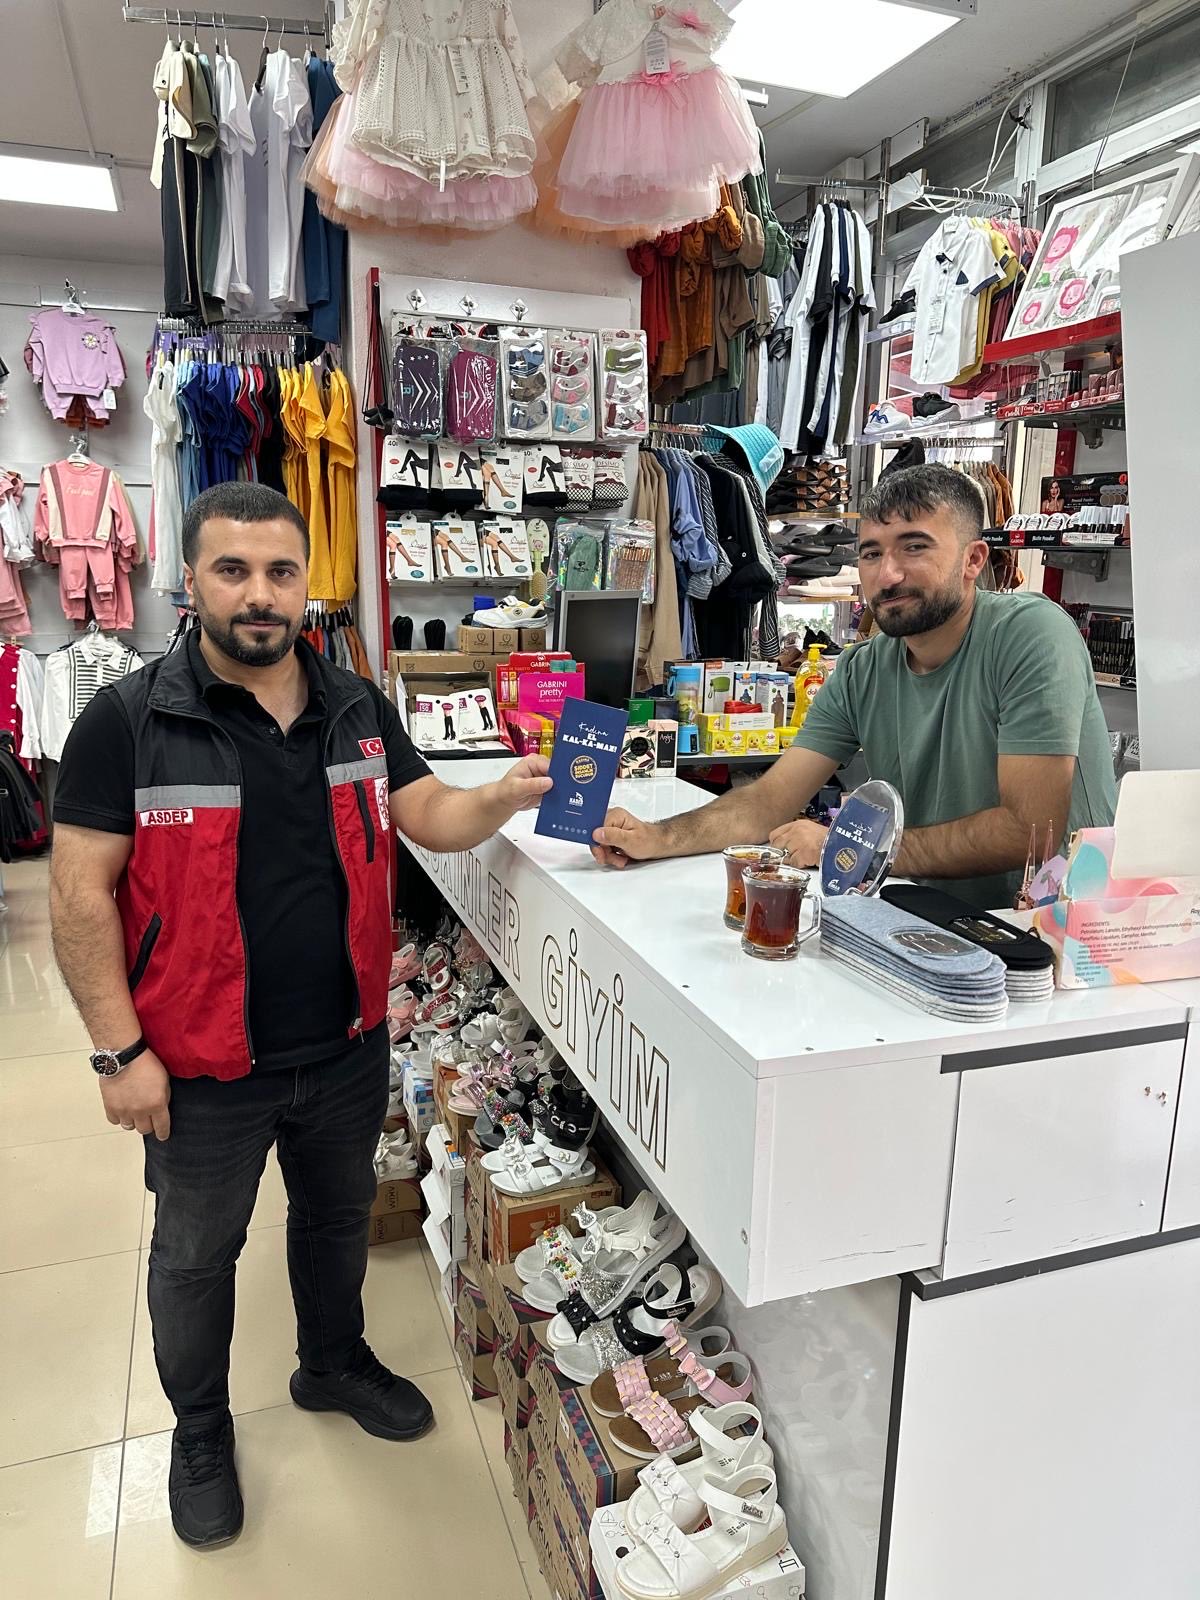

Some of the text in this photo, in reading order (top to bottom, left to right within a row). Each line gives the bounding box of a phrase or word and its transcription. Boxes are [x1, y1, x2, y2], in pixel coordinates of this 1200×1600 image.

[537, 680, 568, 688] GABRINI
[540, 688, 563, 698] pretty
[586, 733, 597, 741] EL
[147, 810, 189, 824] ASDEP
[540, 927, 670, 1173] GİYİM
